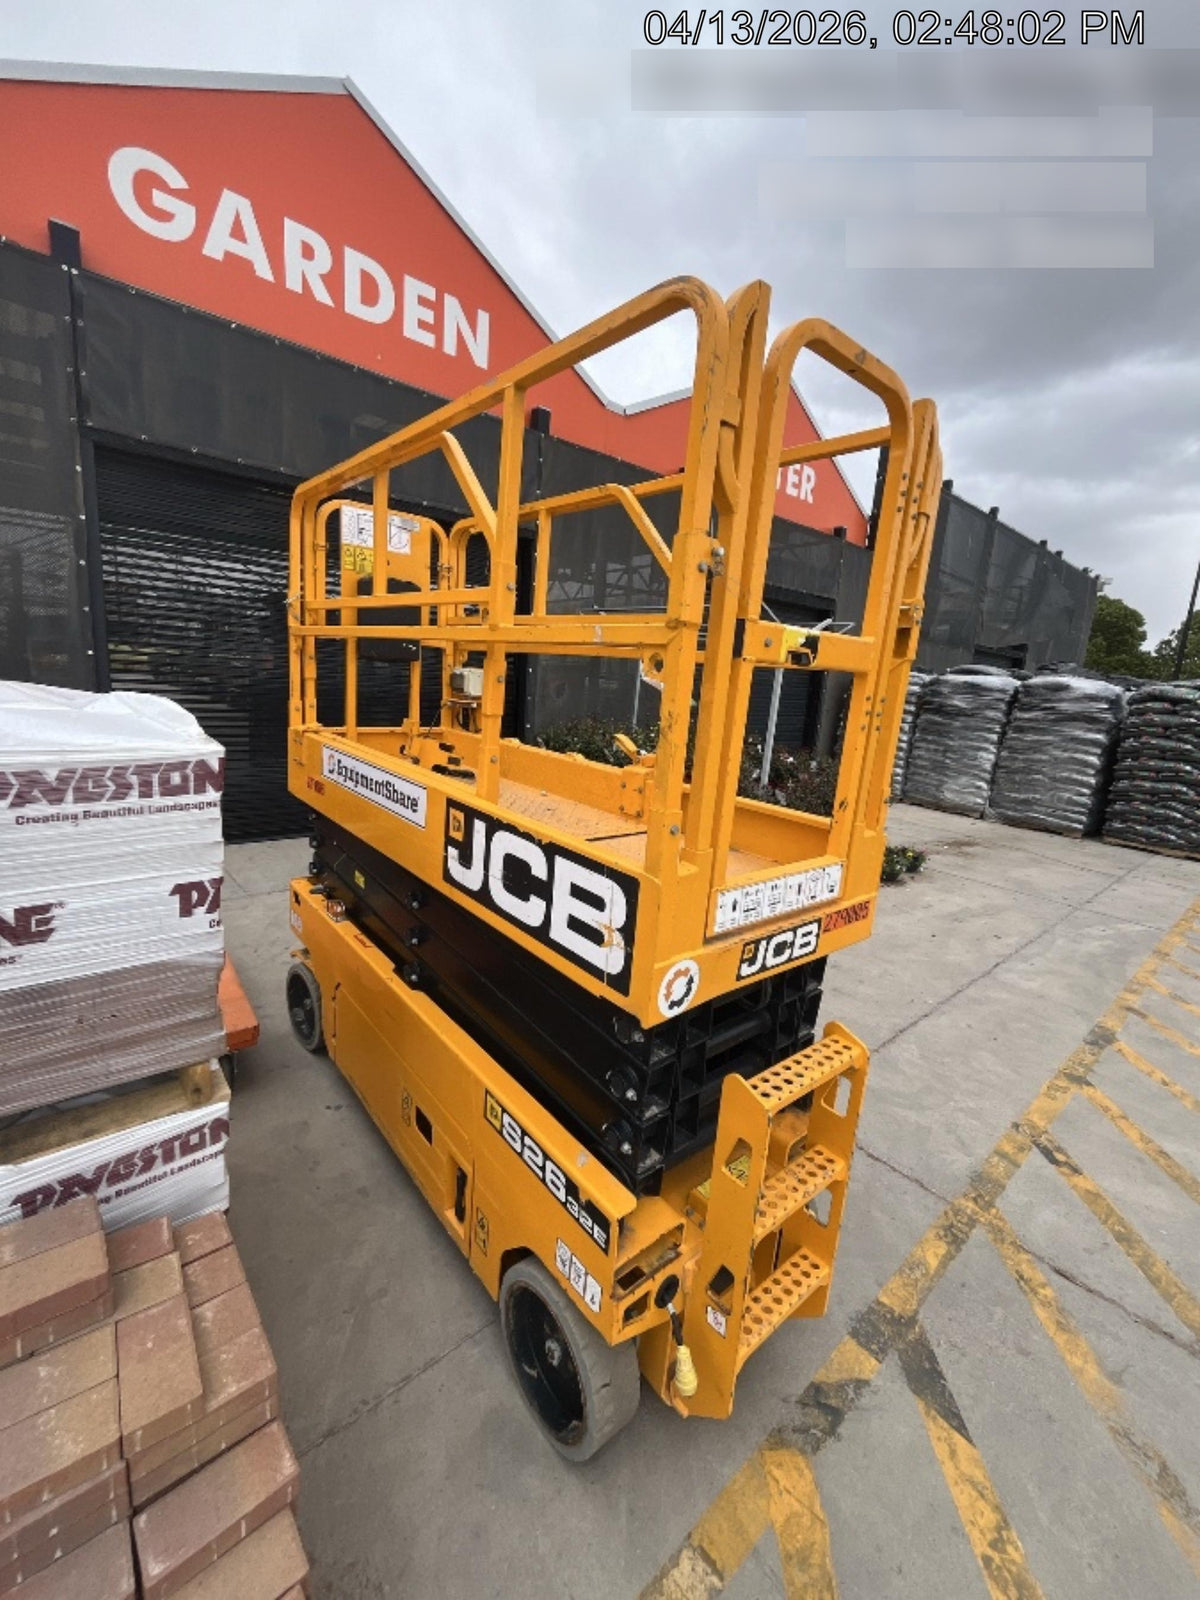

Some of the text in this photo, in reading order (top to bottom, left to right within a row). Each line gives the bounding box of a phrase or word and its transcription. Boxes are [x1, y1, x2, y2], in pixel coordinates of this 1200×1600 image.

[107, 146, 490, 370] GARDEN
[337, 758, 419, 813] EquipmentShare
[15, 812, 79, 827] Creating
[82, 806, 145, 821] Beautiful
[446, 817, 628, 976] JCB
[740, 922, 820, 978] JCB
